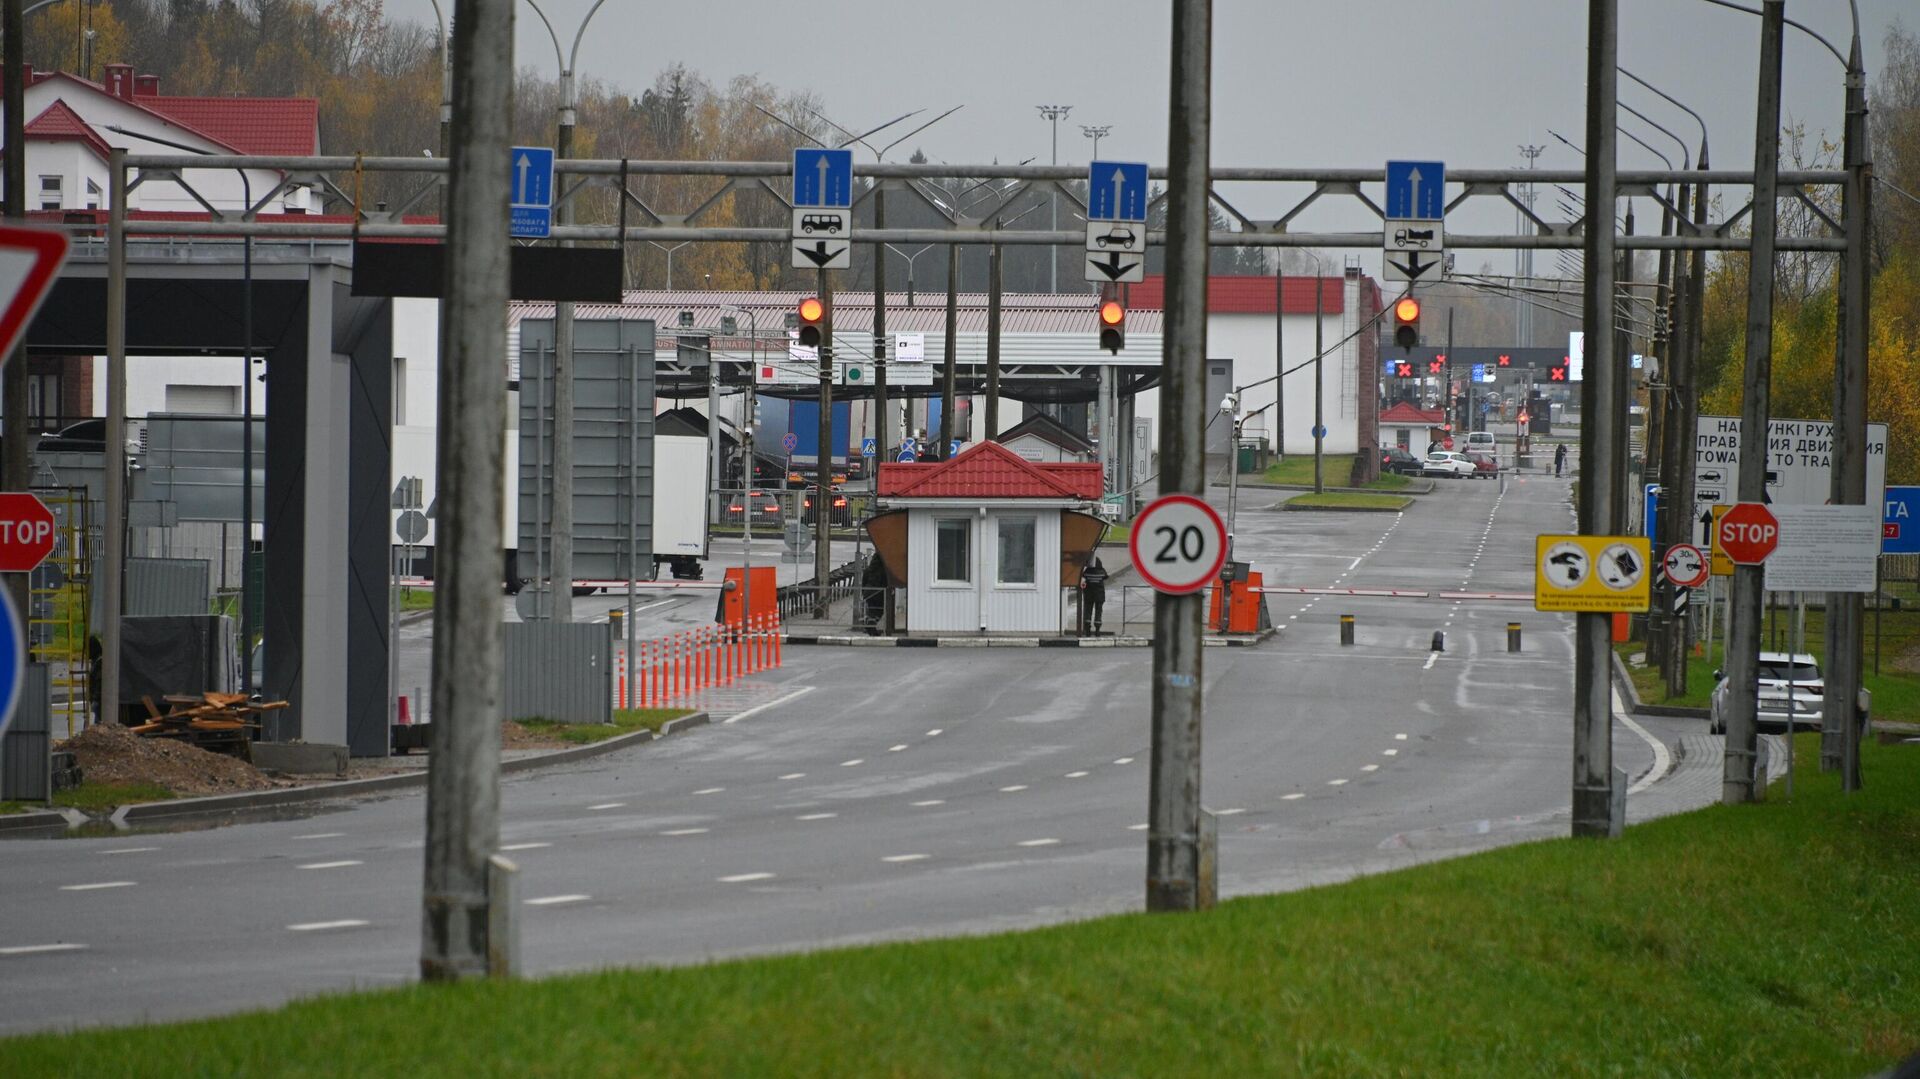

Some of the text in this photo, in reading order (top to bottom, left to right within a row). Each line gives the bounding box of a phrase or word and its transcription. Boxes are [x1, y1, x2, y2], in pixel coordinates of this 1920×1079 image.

[1806, 424, 1834, 437] РУХ
[1775, 454, 1794, 466] TO
[1800, 455, 1831, 467] TRA
[1886, 501, 1909, 518] ГА
[0, 520, 50, 544] TOP
[1722, 522, 1775, 543] STOP
[1154, 525, 1204, 563] 20
